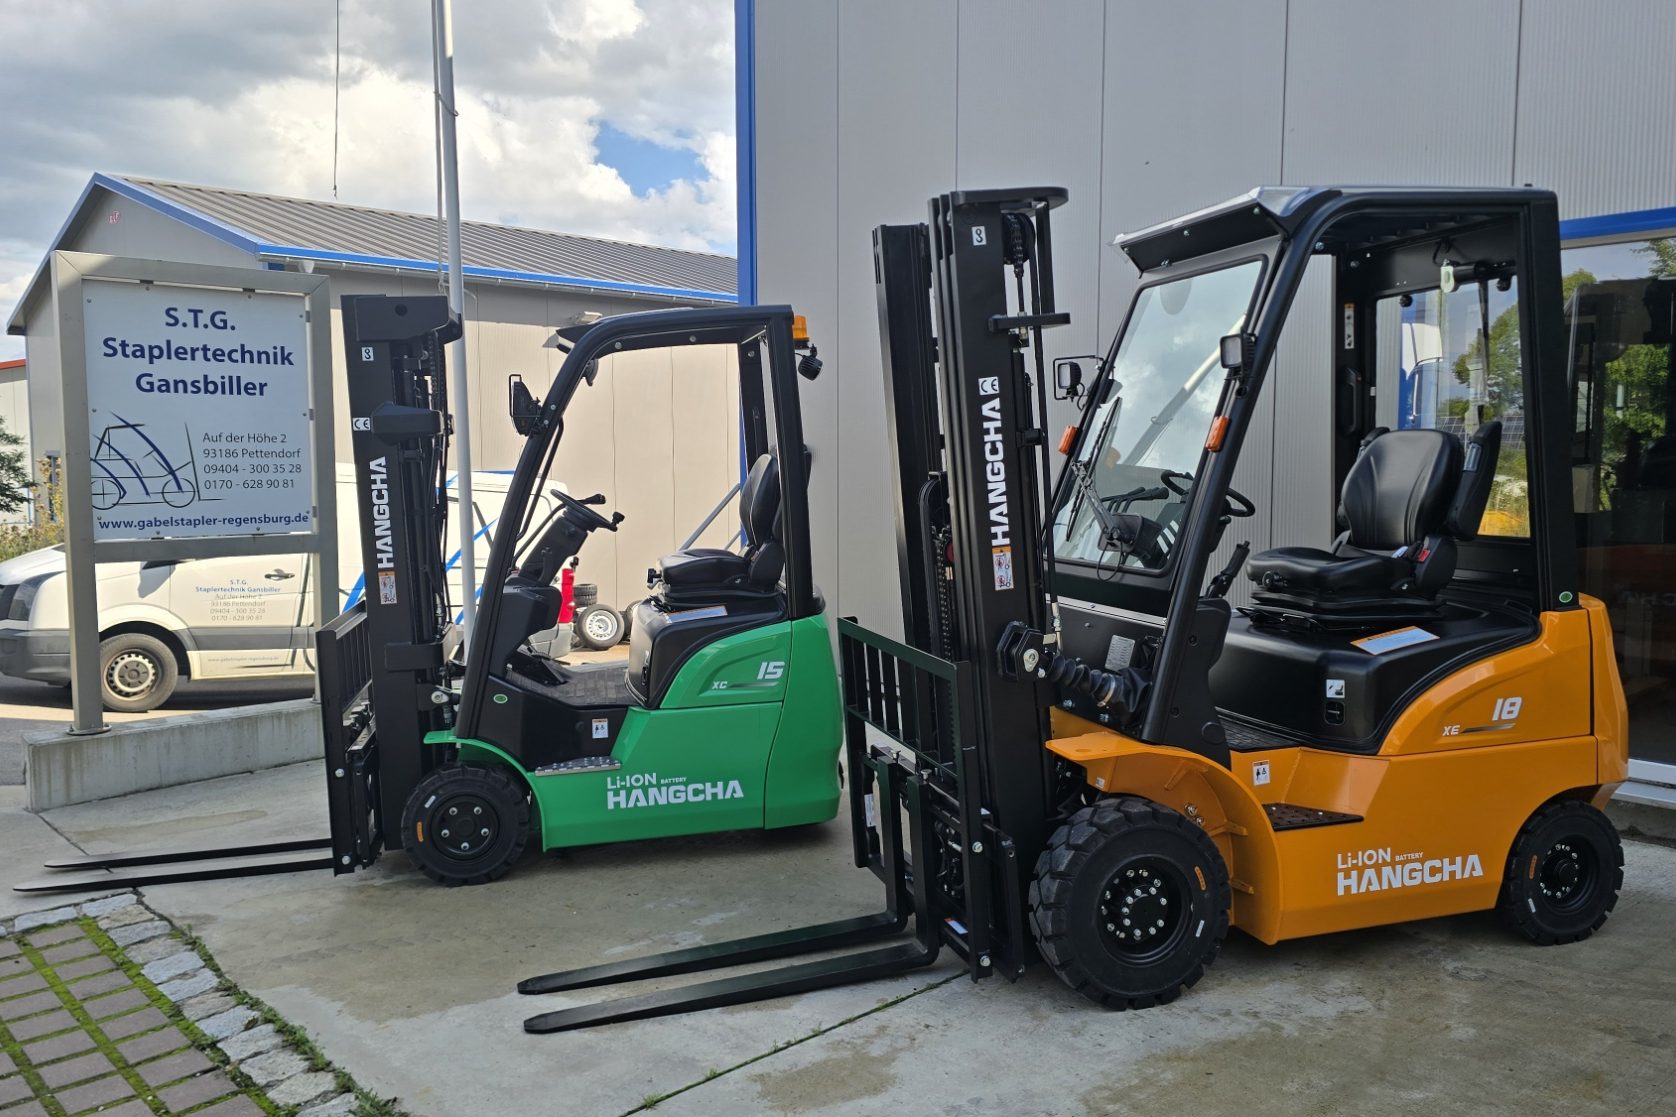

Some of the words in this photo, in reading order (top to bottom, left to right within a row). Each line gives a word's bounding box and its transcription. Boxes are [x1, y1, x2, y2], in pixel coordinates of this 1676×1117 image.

[165, 307, 236, 331] S.T.G.
[102, 337, 295, 366] Staplertechnik
[135, 373, 268, 396] Gansbiller
[203, 432, 223, 443] Auf
[225, 433, 244, 443] der
[247, 433, 278, 443] Höhe
[280, 434, 287, 443] 2
[203, 448, 239, 458] 93186
[241, 447, 301, 459] Pettendorf
[203, 463, 239, 474] 09404
[249, 463, 270, 474] 300
[272, 463, 286, 473] 35
[288, 463, 302, 473] 28
[981, 398, 1010, 546] HANGCHA
[204, 479, 233, 490] 0170
[242, 479, 263, 489] 628
[266, 479, 280, 488] 90
[282, 478, 294, 488] 81
[99, 513, 309, 531] www.gabelstapler-regensburg.de
[369, 456, 394, 569] HANGCHA
[757, 661, 785, 680] 15
[712, 681, 728, 689] XC
[1492, 697, 1522, 720] 18
[1442, 725, 1460, 736] XE
[607, 780, 744, 809] HANGCHA
[1395, 852, 1424, 862] BATTERY
[1337, 854, 1483, 896] HANGCHA
